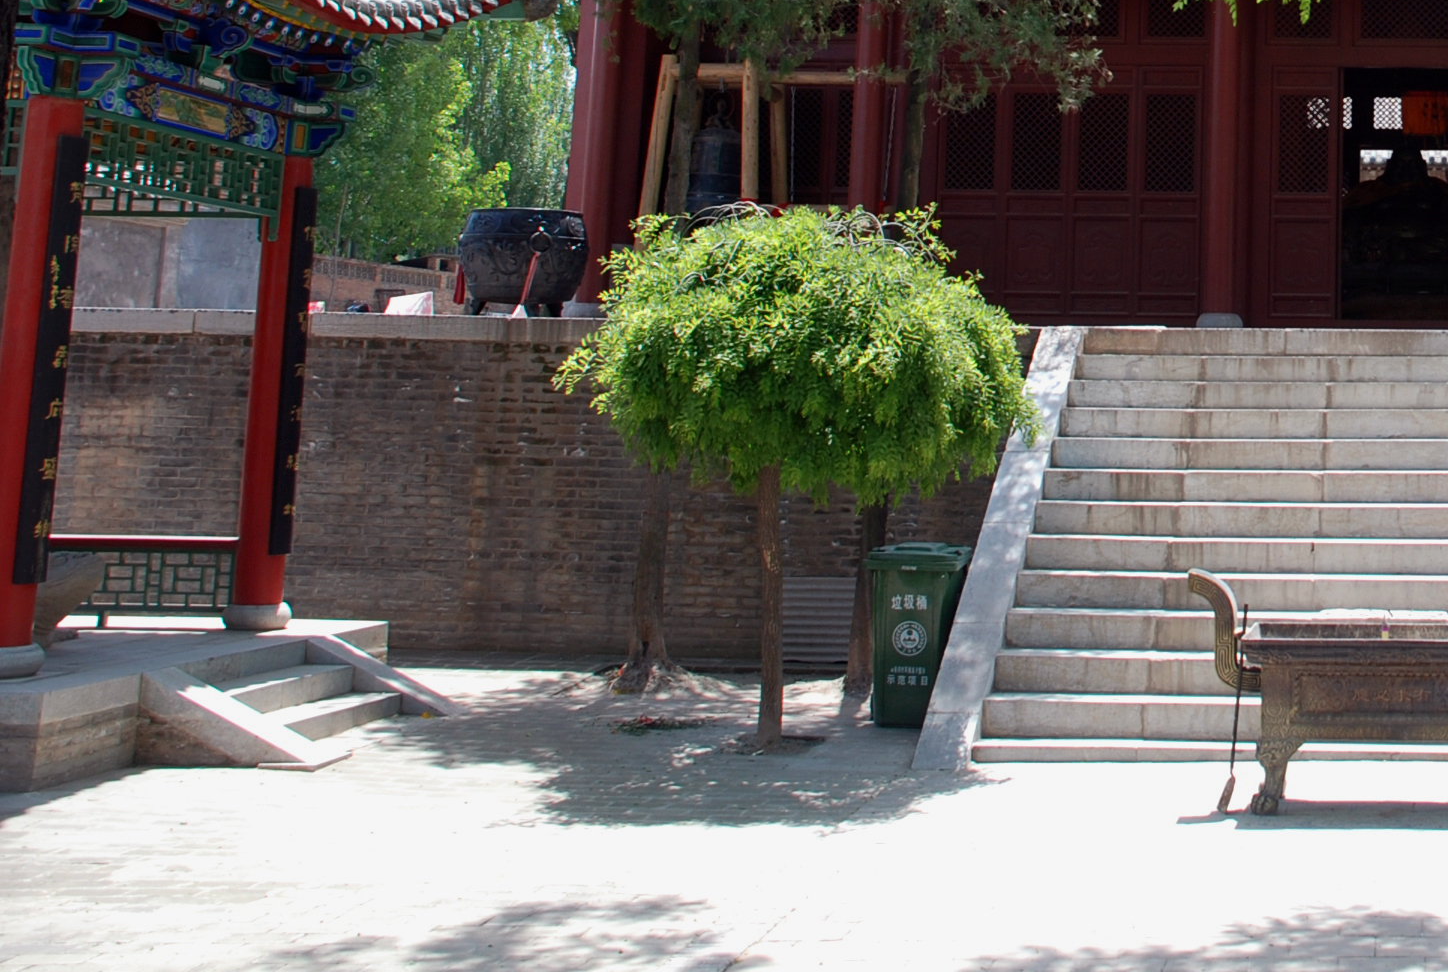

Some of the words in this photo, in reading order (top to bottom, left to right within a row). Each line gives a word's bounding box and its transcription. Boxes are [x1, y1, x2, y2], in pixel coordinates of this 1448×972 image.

[891, 594, 928, 610] 垃圾桶
[886, 674, 929, 686] 示范项目
